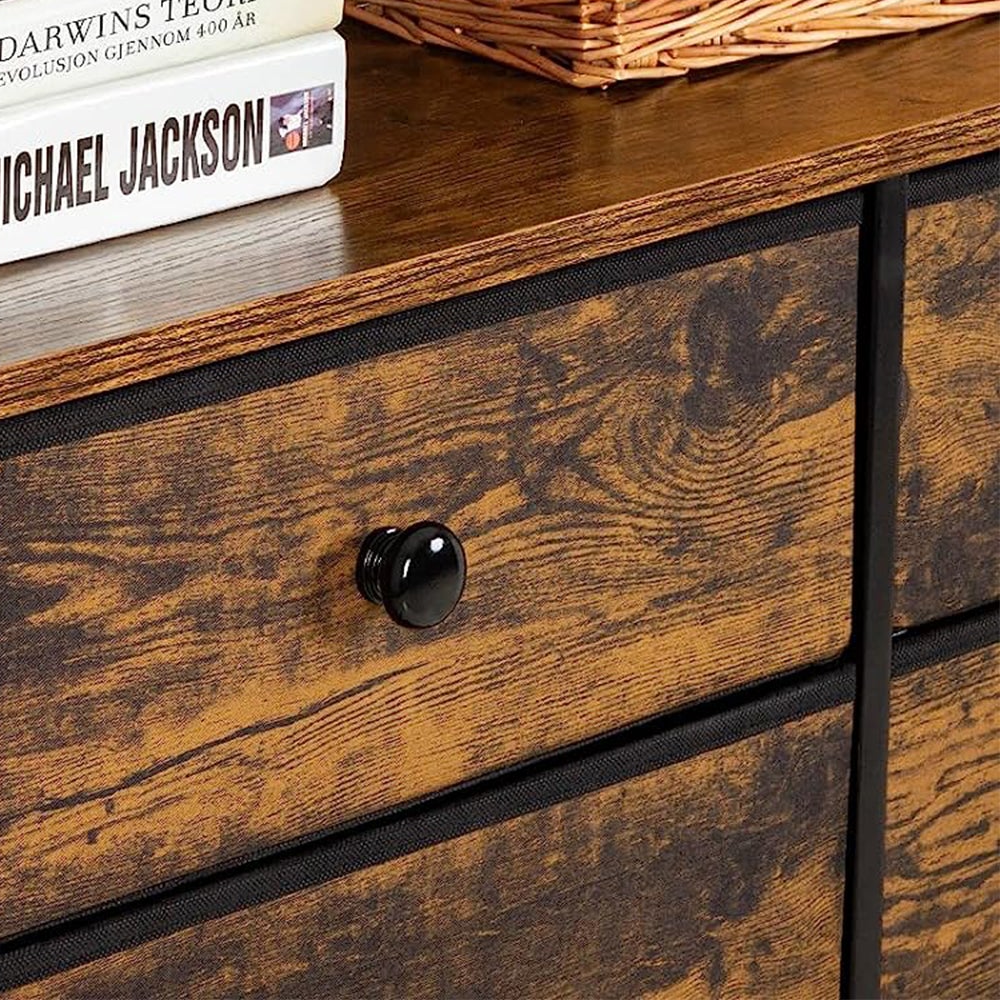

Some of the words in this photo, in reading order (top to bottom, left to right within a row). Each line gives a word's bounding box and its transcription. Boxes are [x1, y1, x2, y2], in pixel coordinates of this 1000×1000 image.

[104, 28, 191, 60] GJENNOM
[196, 19, 228, 38] 400
[231, 11, 256, 30] ÅR
[119, 98, 265, 196] JACKSON
